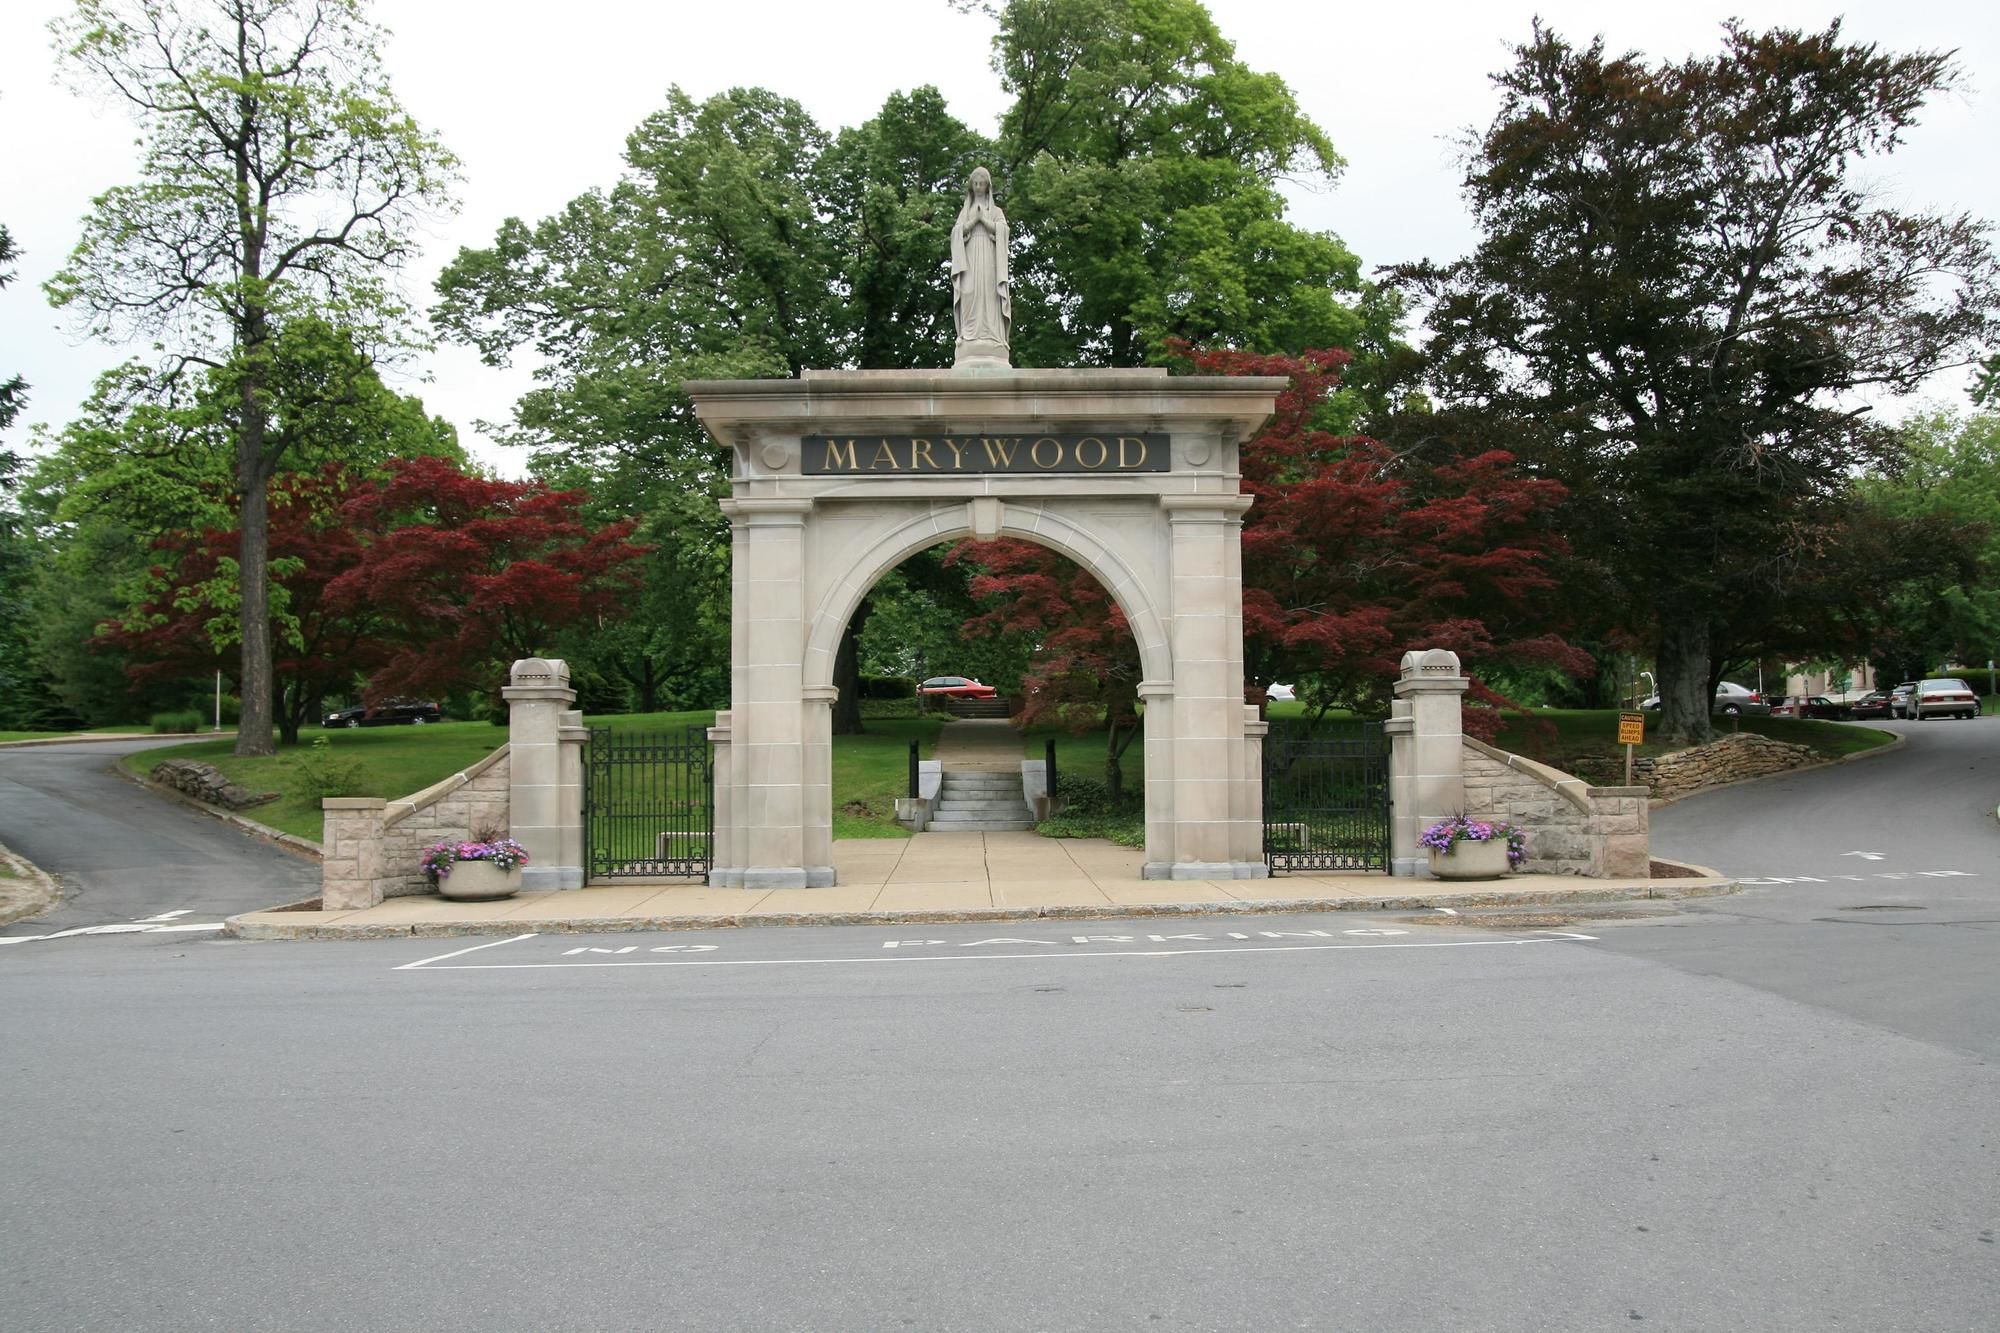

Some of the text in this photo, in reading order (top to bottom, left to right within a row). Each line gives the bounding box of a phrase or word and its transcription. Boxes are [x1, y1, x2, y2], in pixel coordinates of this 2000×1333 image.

[822, 437, 1148, 470] MARYWOOD
[560, 928, 1410, 956] NO PARKING
